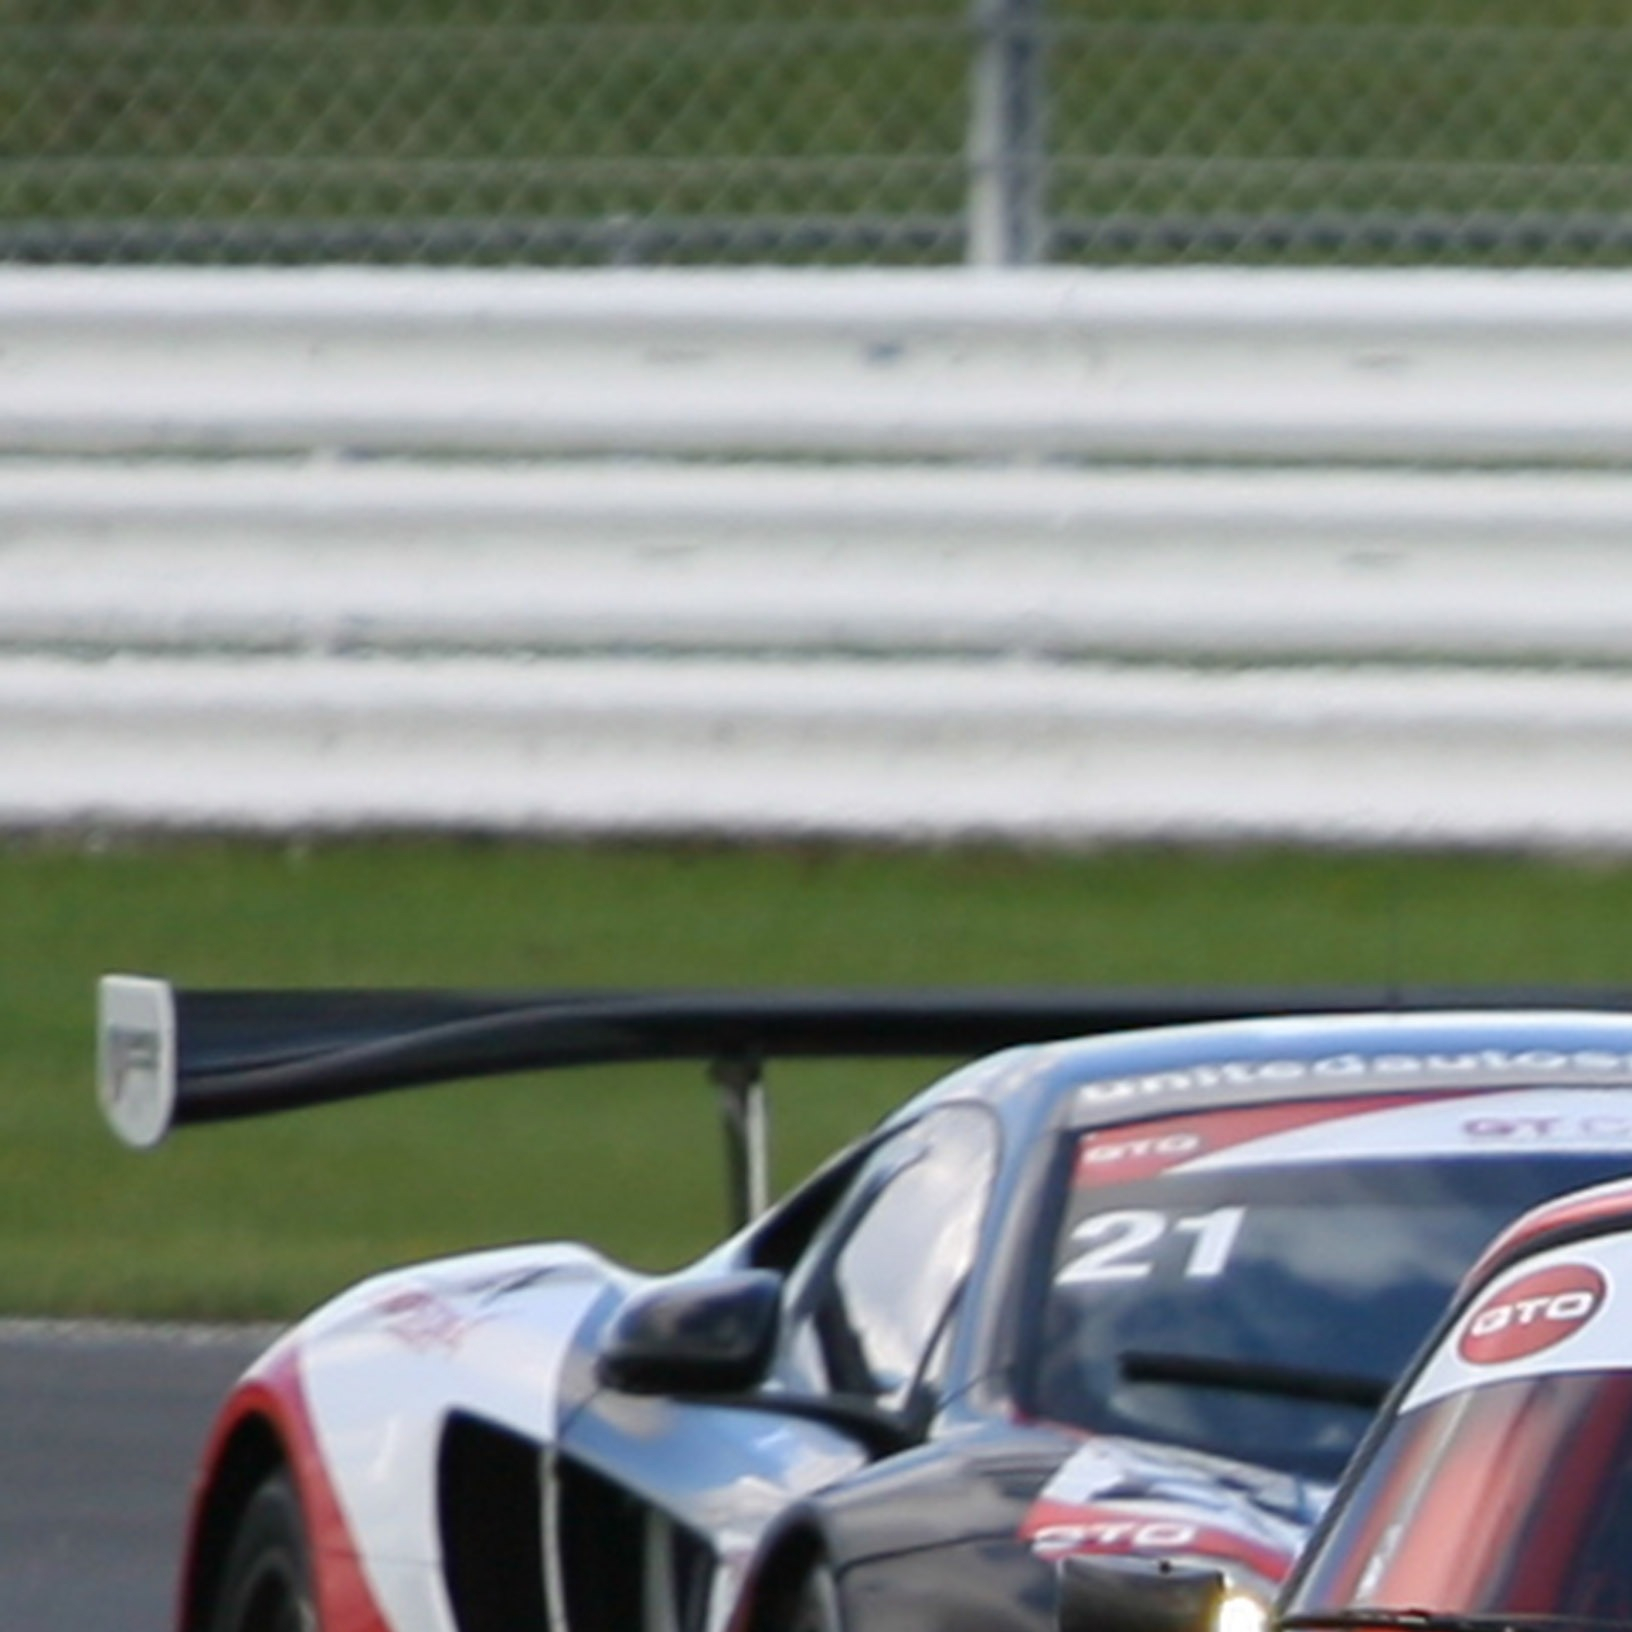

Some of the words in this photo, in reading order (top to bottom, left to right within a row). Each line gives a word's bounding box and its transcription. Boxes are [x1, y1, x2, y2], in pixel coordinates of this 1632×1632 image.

[1082, 1133, 1200, 1162] GTO
[1055, 1206, 1246, 1285] 21
[1471, 1291, 1594, 1338] GTO
[1032, 1521, 1197, 1556] GTO
